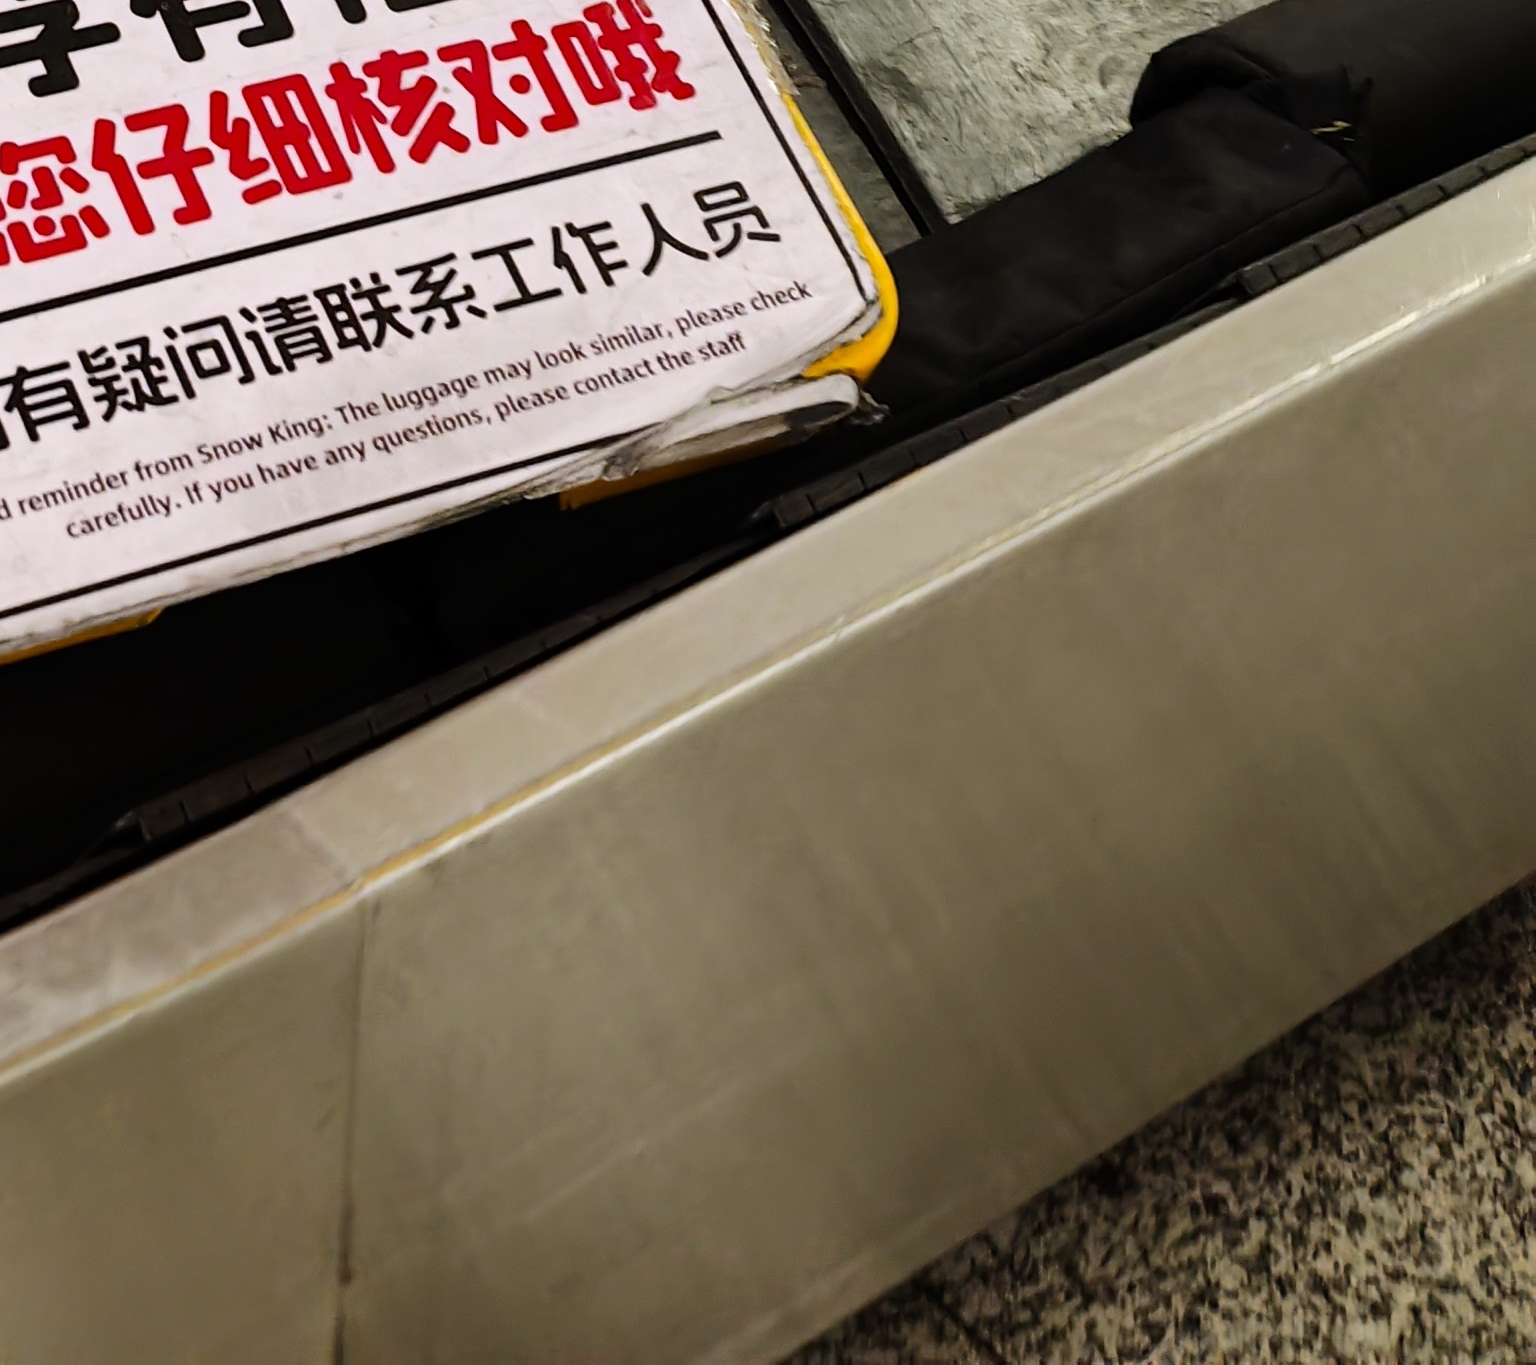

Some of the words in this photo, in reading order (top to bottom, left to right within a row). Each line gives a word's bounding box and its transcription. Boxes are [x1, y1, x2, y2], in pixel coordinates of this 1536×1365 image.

[17, 468, 129, 516] reminder
[133, 453, 194, 482] from
[197, 432, 264, 464] Snow
[268, 413, 334, 446] King:
[335, 397, 381, 425] The
[380, 372, 481, 414] luggage
[484, 357, 532, 386] may
[534, 339, 586, 370] look
[590, 320, 673, 357] similar,
[675, 297, 749, 337] please
[750, 279, 813, 312] check
[65, 492, 181, 540] carefully.
[184, 480, 204, 506] If
[208, 473, 256, 505] you
[257, 451, 317, 485] have
[324, 439, 366, 468] any
[372, 404, 492, 454] questions,
[494, 384, 570, 423] please
[572, 356, 658, 397] contact
[658, 344, 696, 372] the
[698, 329, 748, 361] staff
